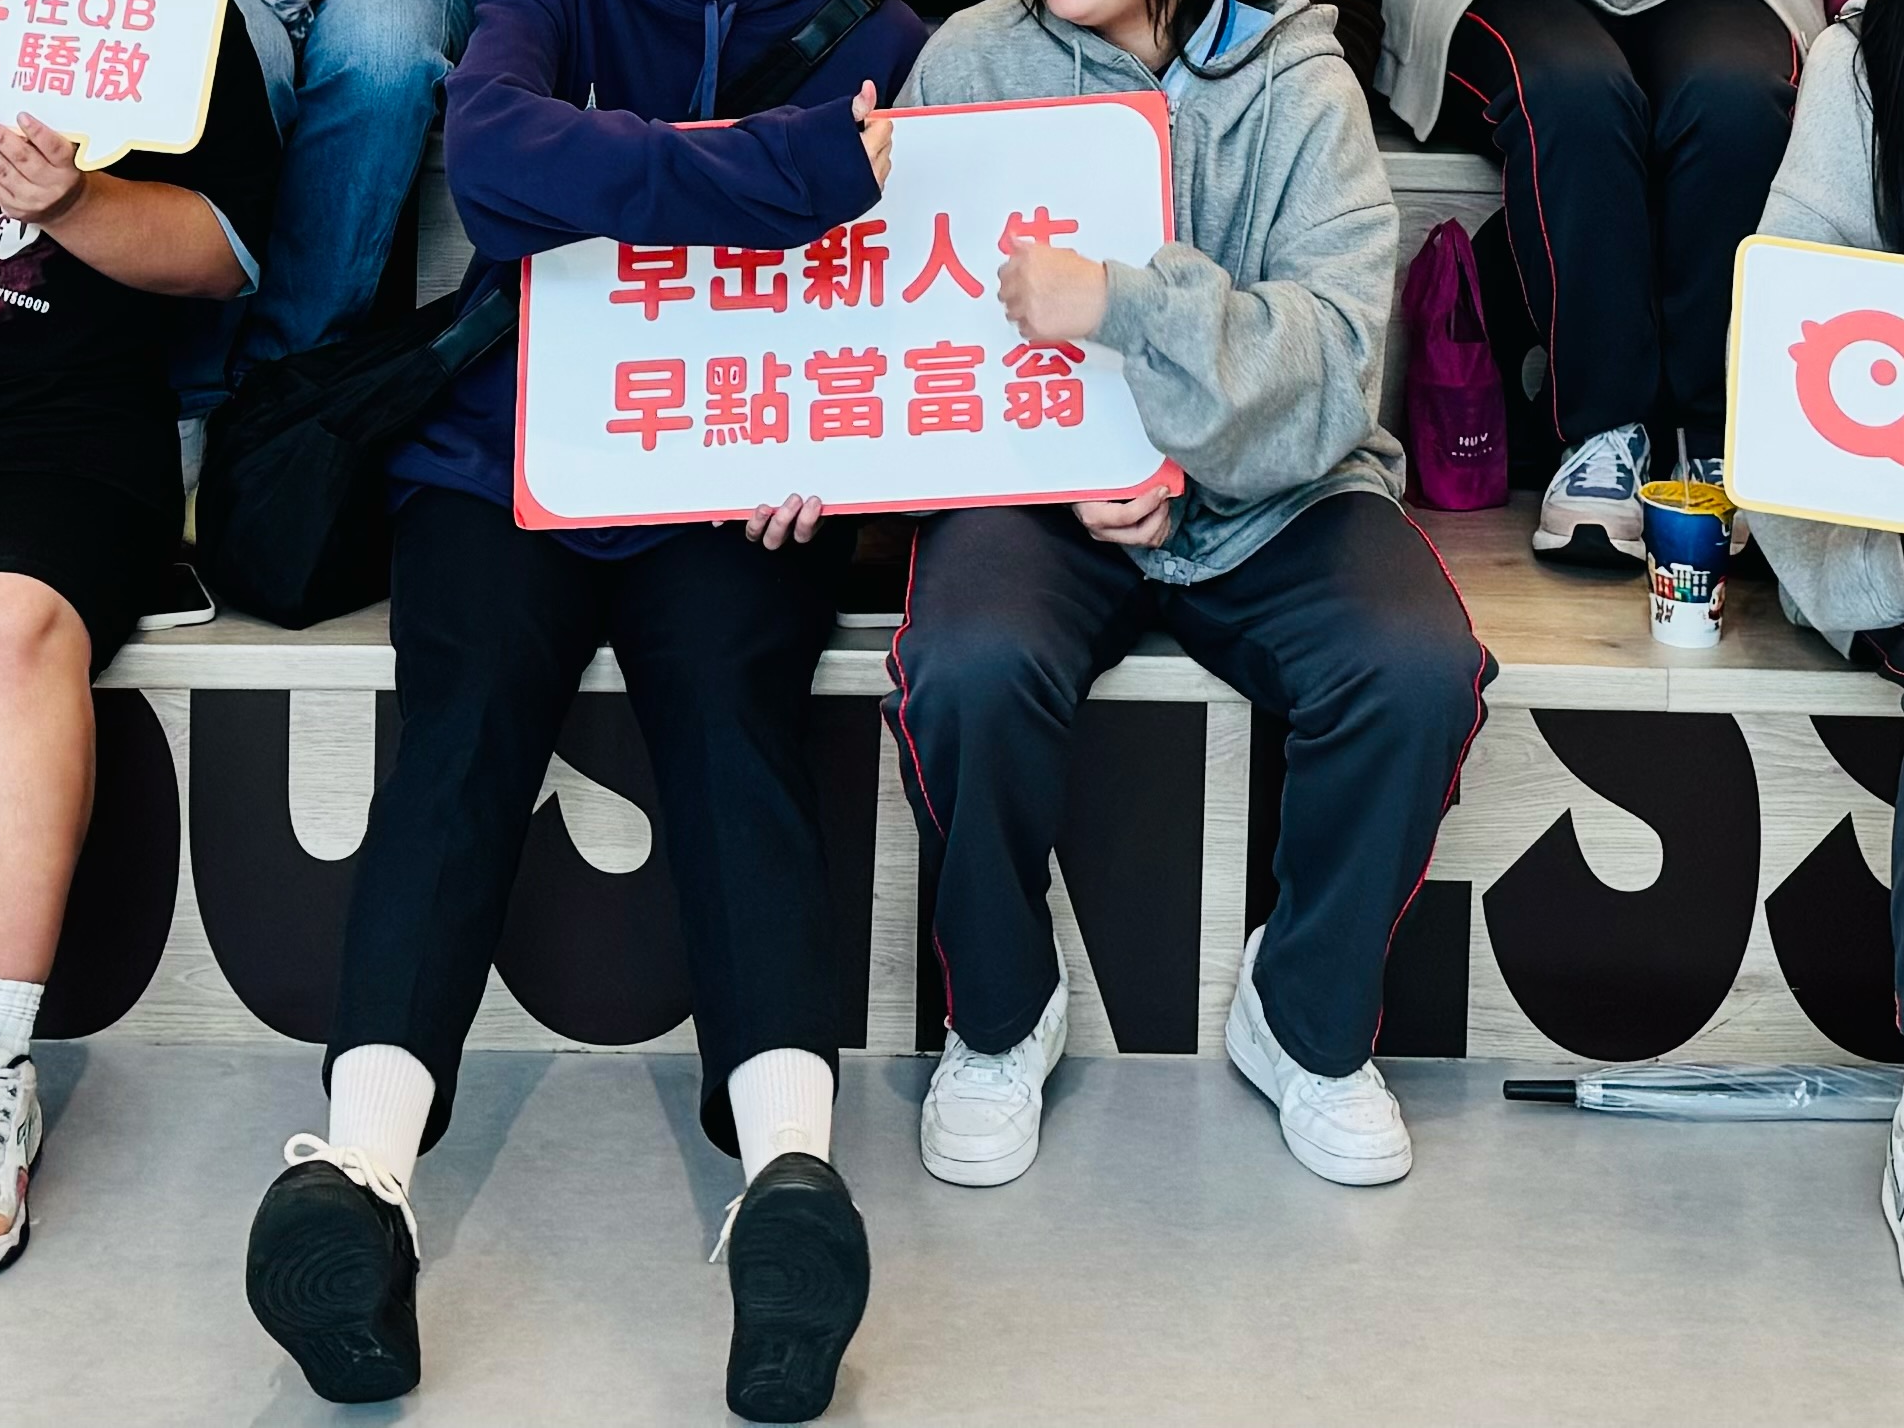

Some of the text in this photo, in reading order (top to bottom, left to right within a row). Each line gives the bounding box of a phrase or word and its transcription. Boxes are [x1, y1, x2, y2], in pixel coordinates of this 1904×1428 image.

[11, 32, 151, 104] 驕傲
[605, 336, 1087, 452] 早點當富翁
